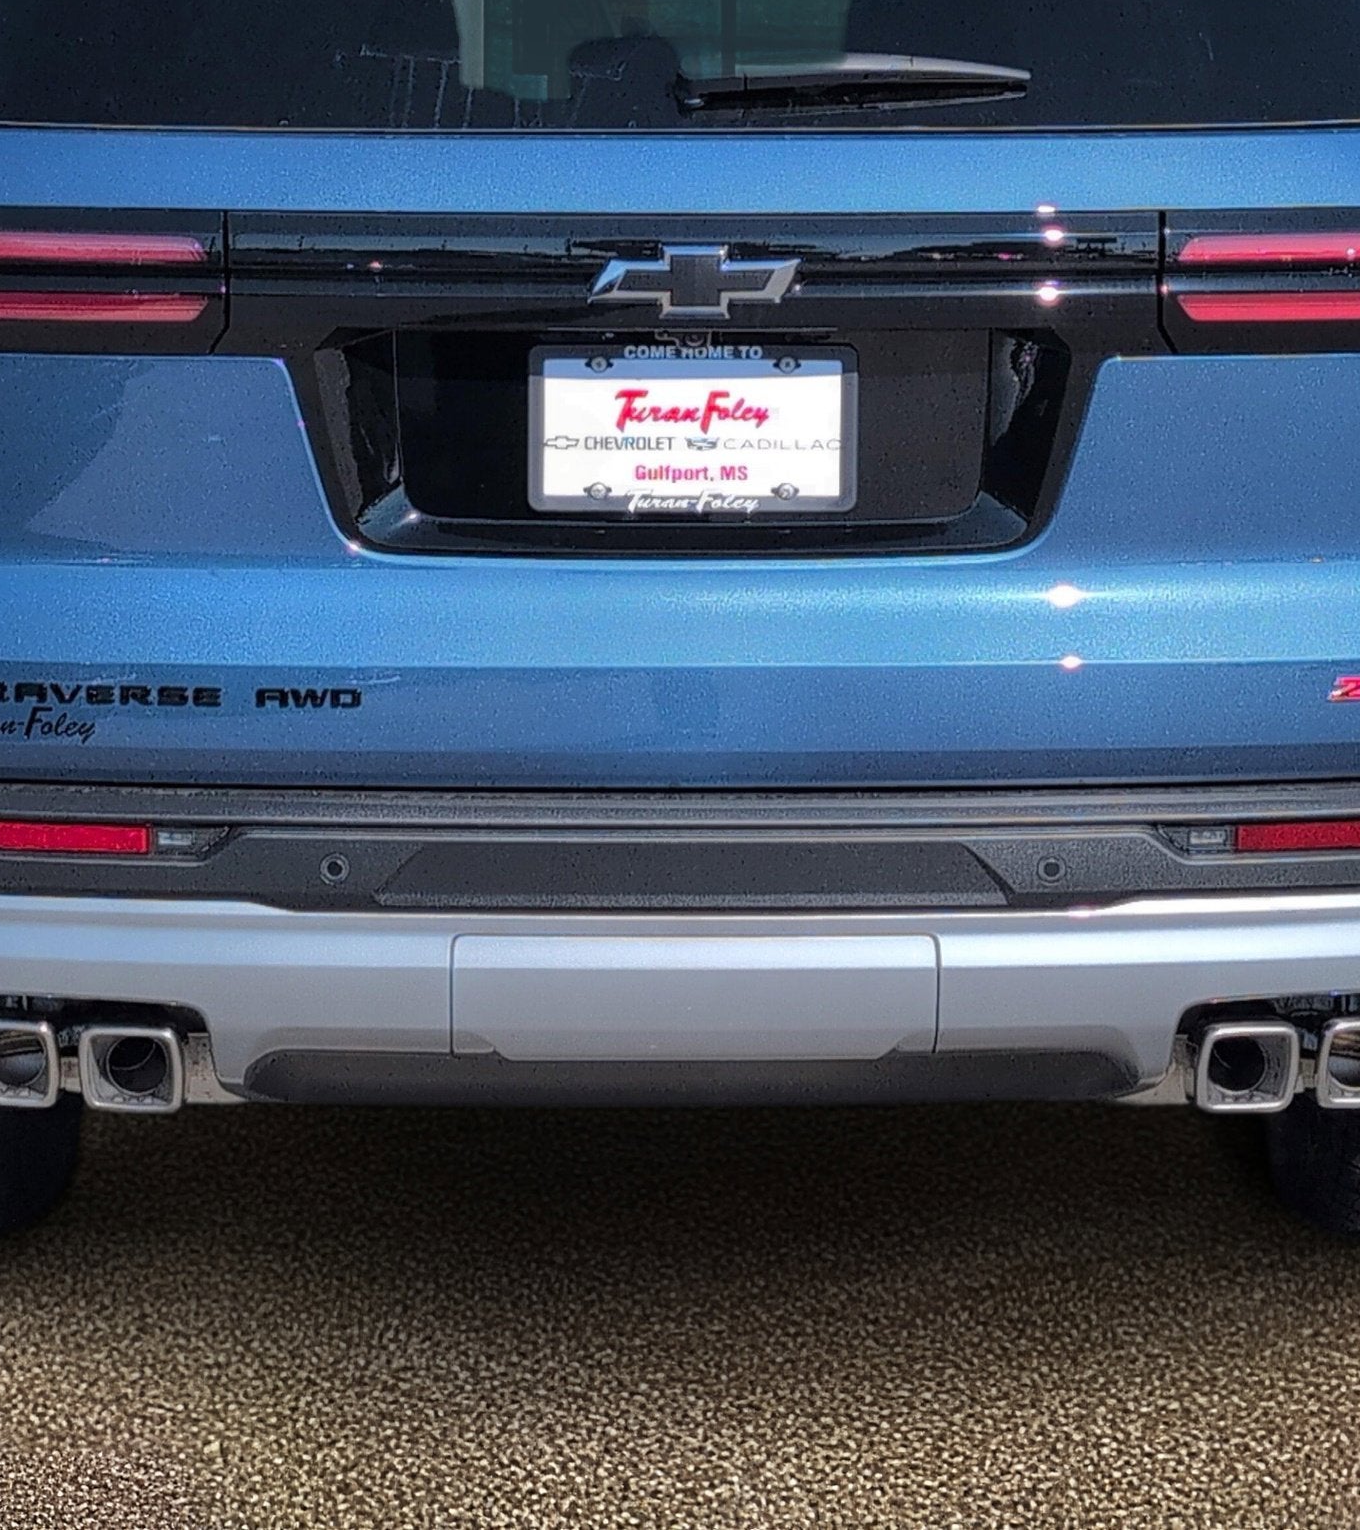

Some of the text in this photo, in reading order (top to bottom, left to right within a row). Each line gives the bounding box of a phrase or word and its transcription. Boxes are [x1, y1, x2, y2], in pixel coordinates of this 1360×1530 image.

[623, 345, 763, 359] COME HOME TO
[584, 436, 842, 451] CHEVROLET CADILLAC
[634, 465, 749, 483] Gulfport, MS
[255, 687, 362, 709] AWD
